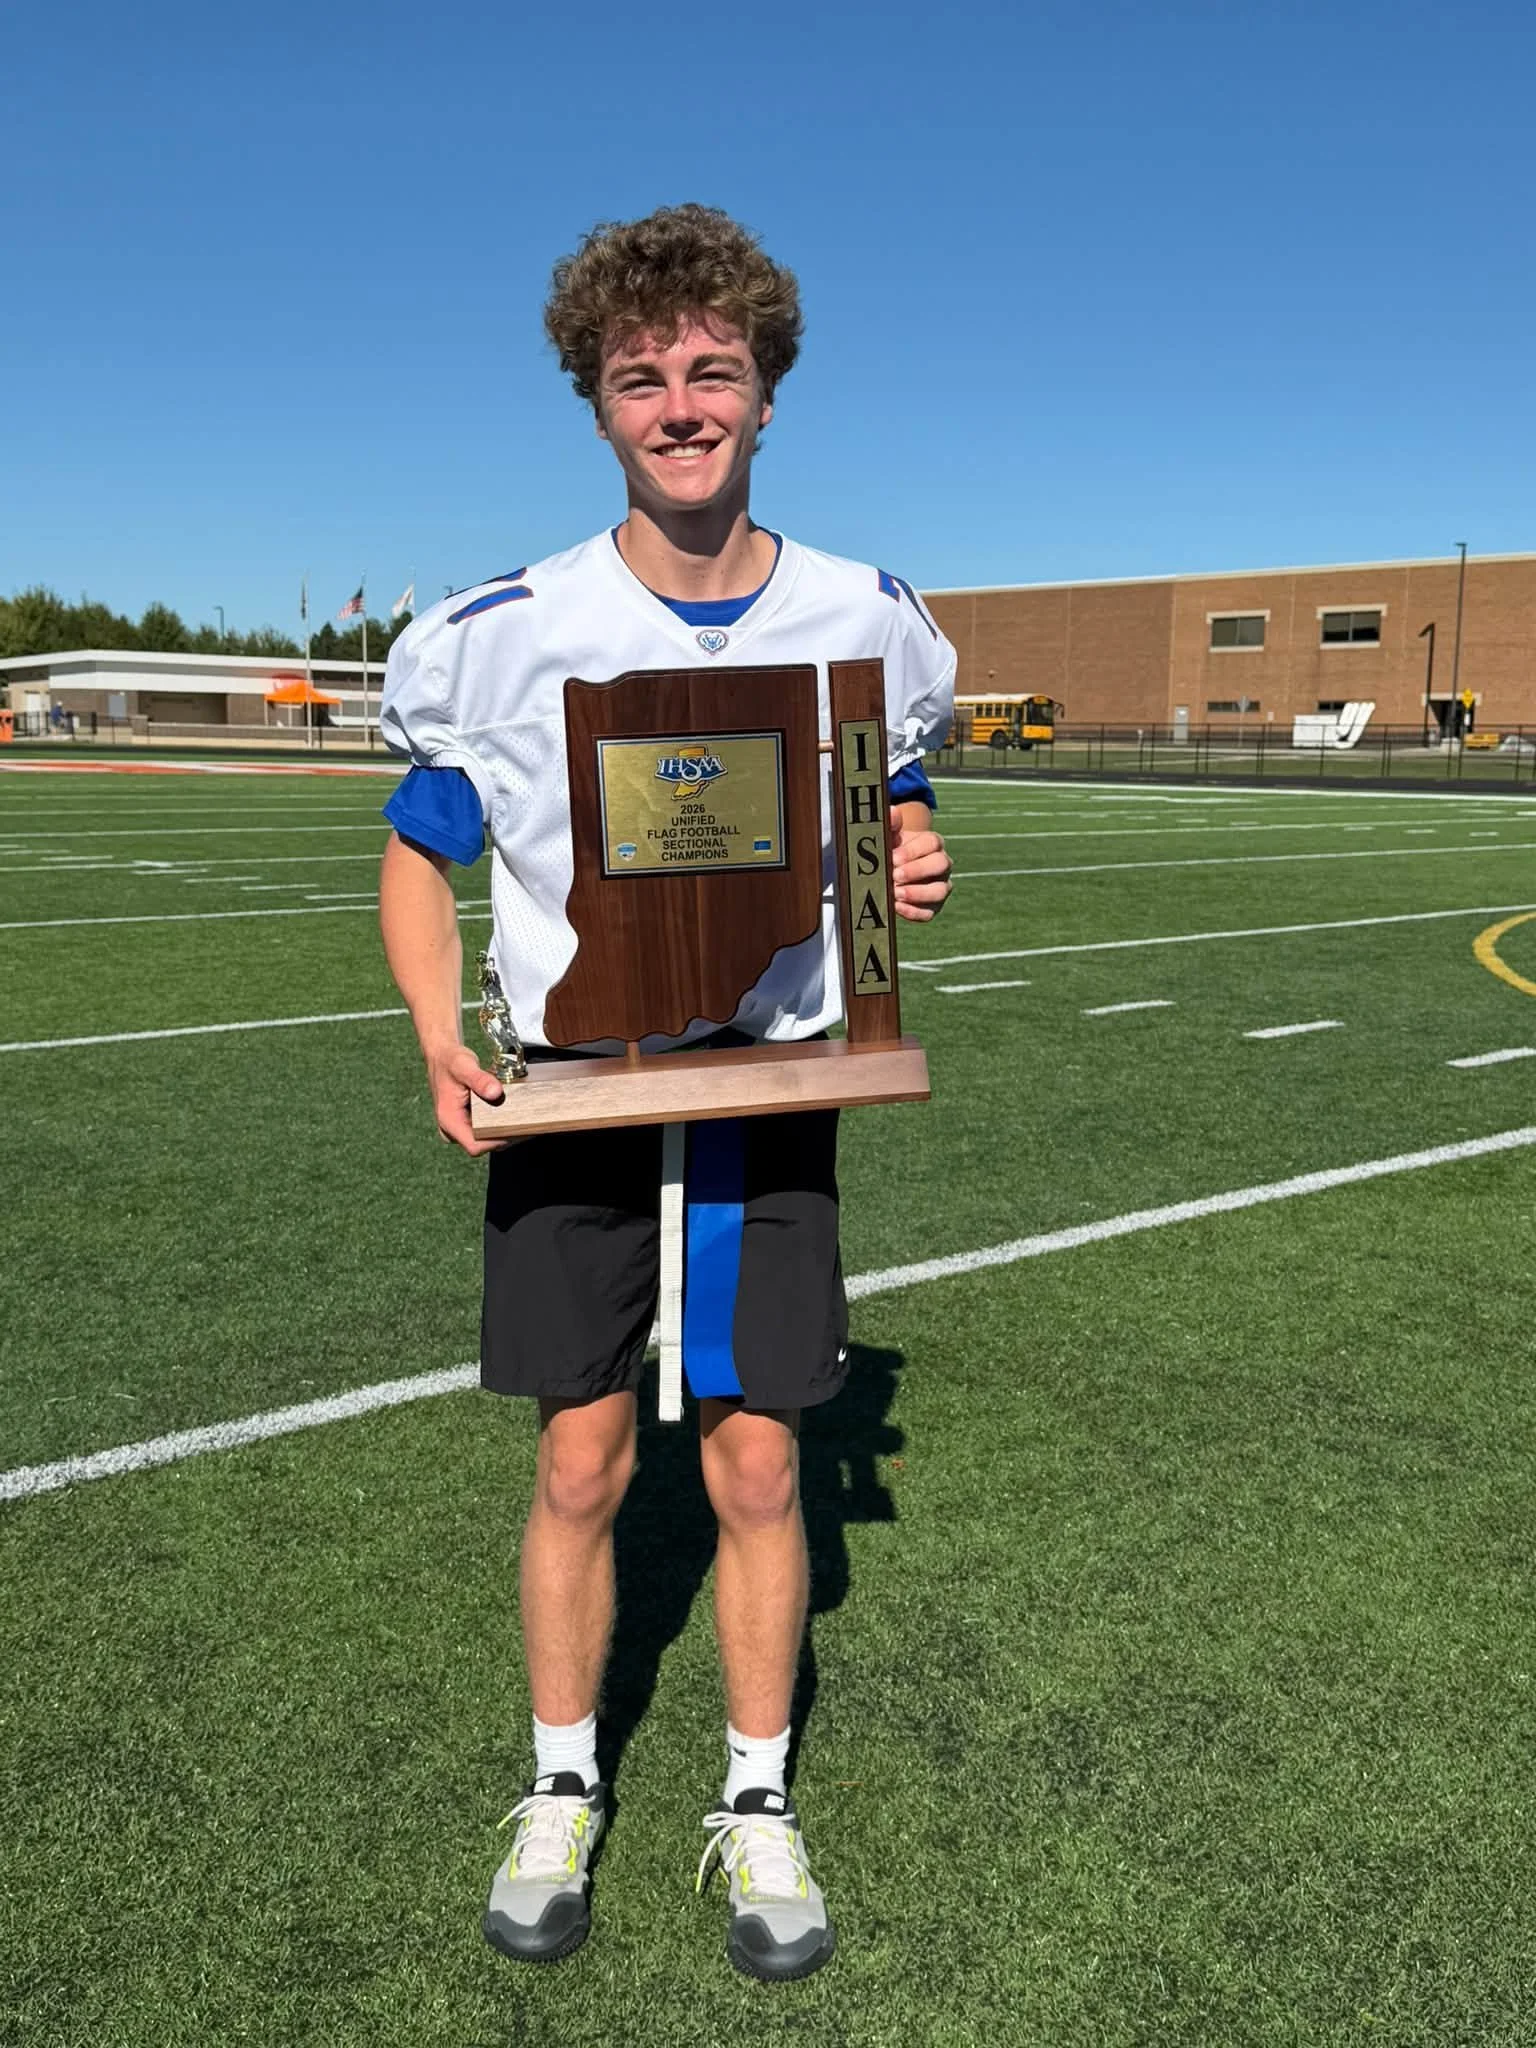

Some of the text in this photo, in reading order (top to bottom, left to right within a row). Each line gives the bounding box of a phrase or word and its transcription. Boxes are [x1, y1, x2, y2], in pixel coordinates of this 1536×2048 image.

[658, 757, 725, 781] IHSAA
[680, 804, 706, 815] 2026
[671, 815, 716, 827] UNIFIED
[647, 825, 741, 840] FLAG FOOTBALL
[662, 838, 727, 850] SECTIONAL
[661, 849, 729, 862] CHAMPIONS
[848, 732, 889, 984] IHSAA
